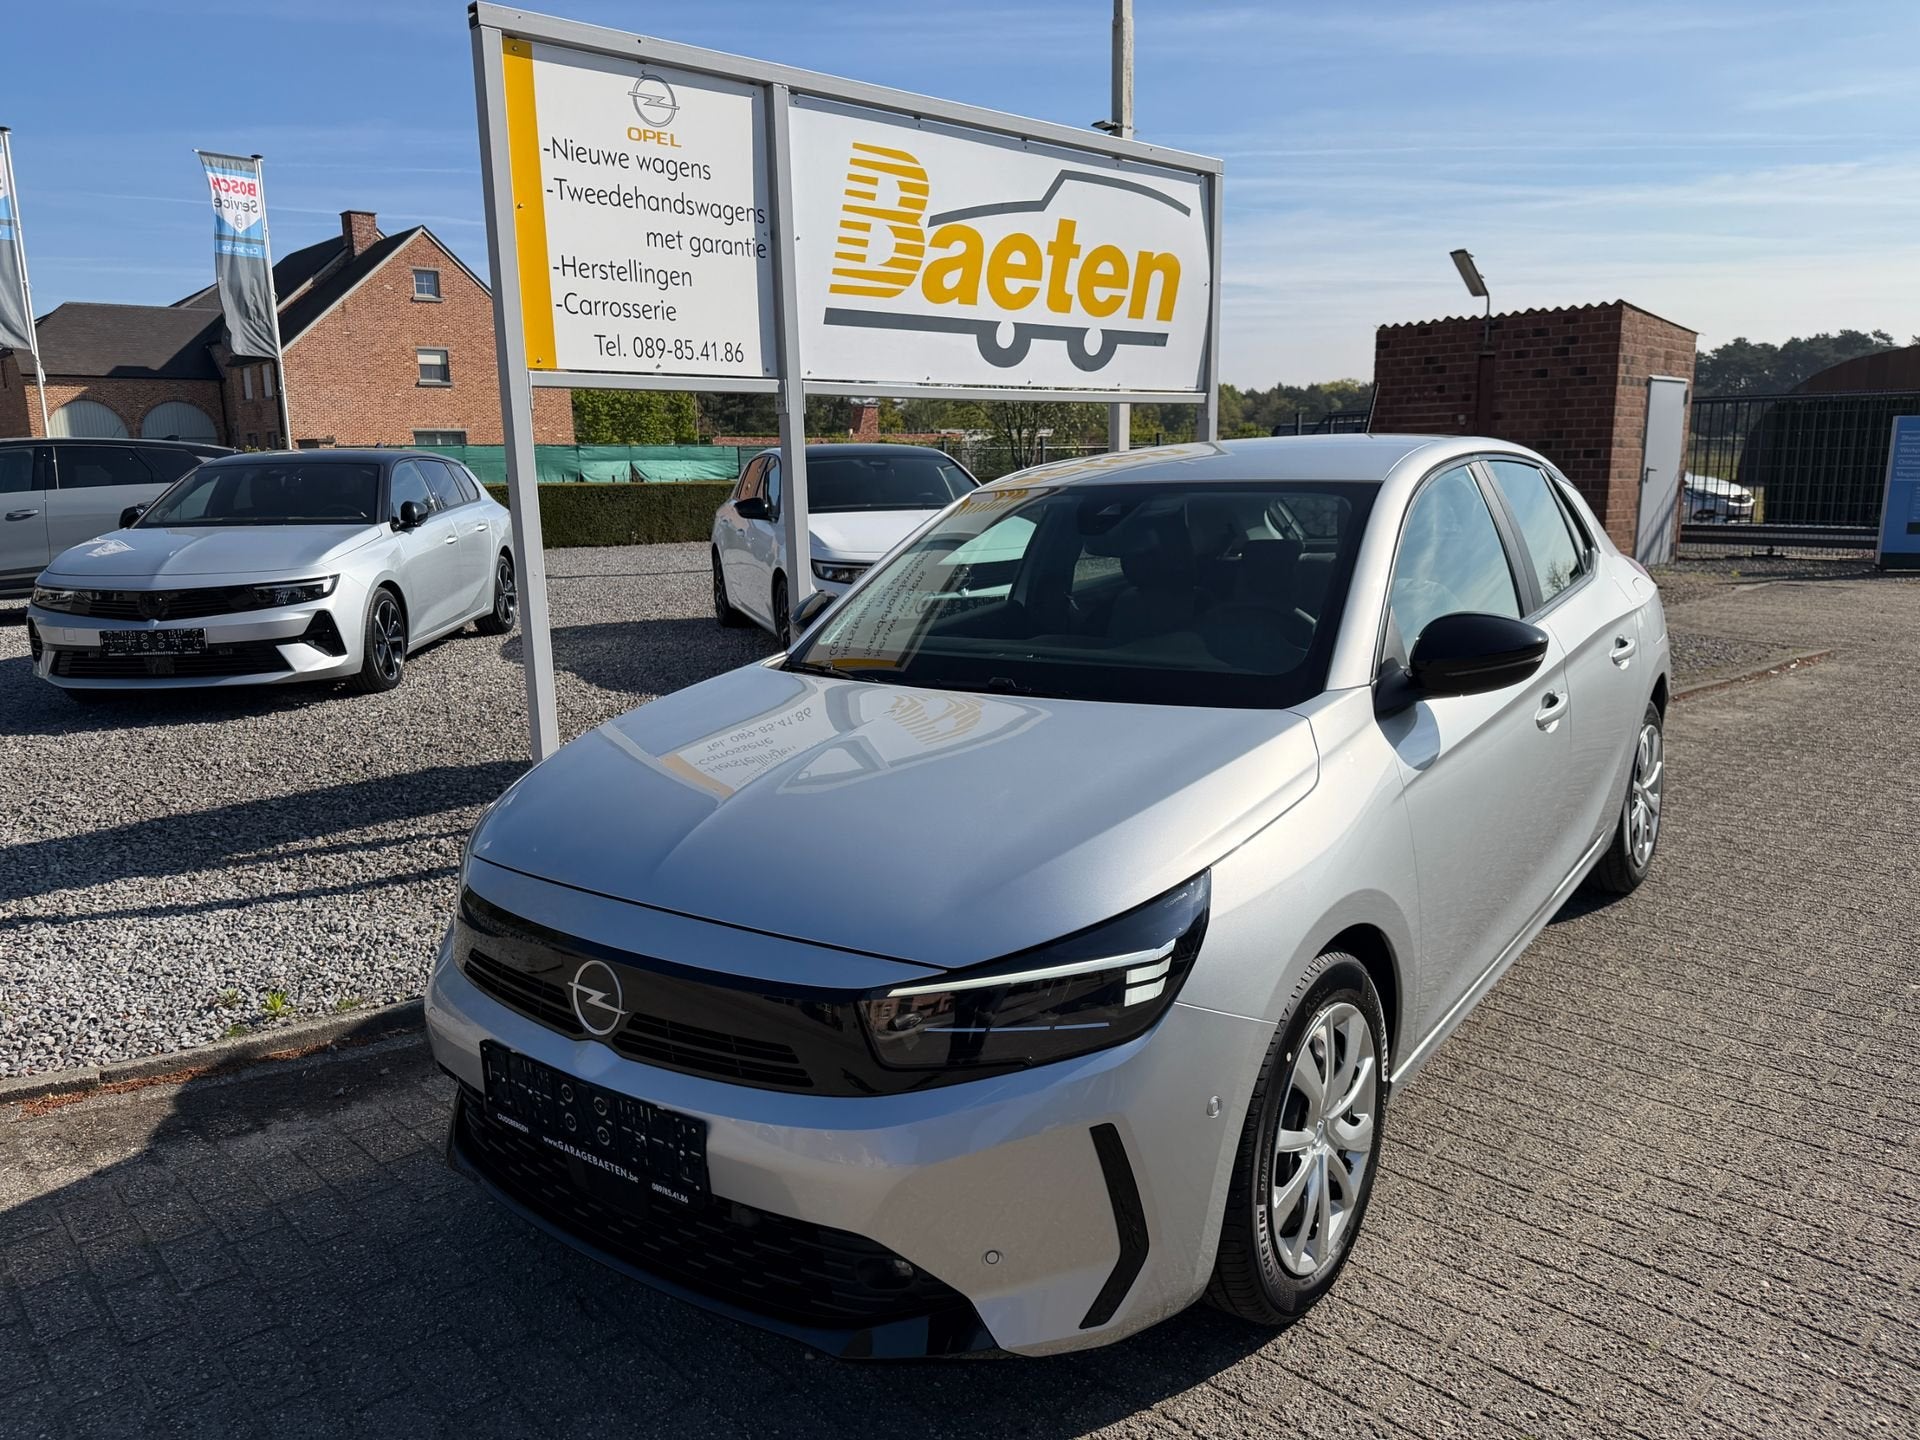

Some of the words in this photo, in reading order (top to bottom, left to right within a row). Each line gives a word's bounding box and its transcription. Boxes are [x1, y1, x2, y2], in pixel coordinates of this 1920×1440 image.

[627, 126, 682, 148] OPEL
[543, 136, 630, 169] -Nieuwe
[636, 154, 711, 182] wagens
[546, 177, 766, 226] -Tweedehandswagens
[646, 230, 683, 250] met
[689, 237, 767, 259] garantie
[829, 142, 1181, 323] Baeten
[553, 255, 693, 290] -Herstellingen
[555, 292, 677, 322] -Carrosserie
[594, 334, 627, 357] Tel.
[633, 336, 744, 363] 089-85.41.86
[542, 1135, 640, 1184] www.GARAGEBAETEN.be
[1257, 1209, 1281, 1290] MICHELIN
